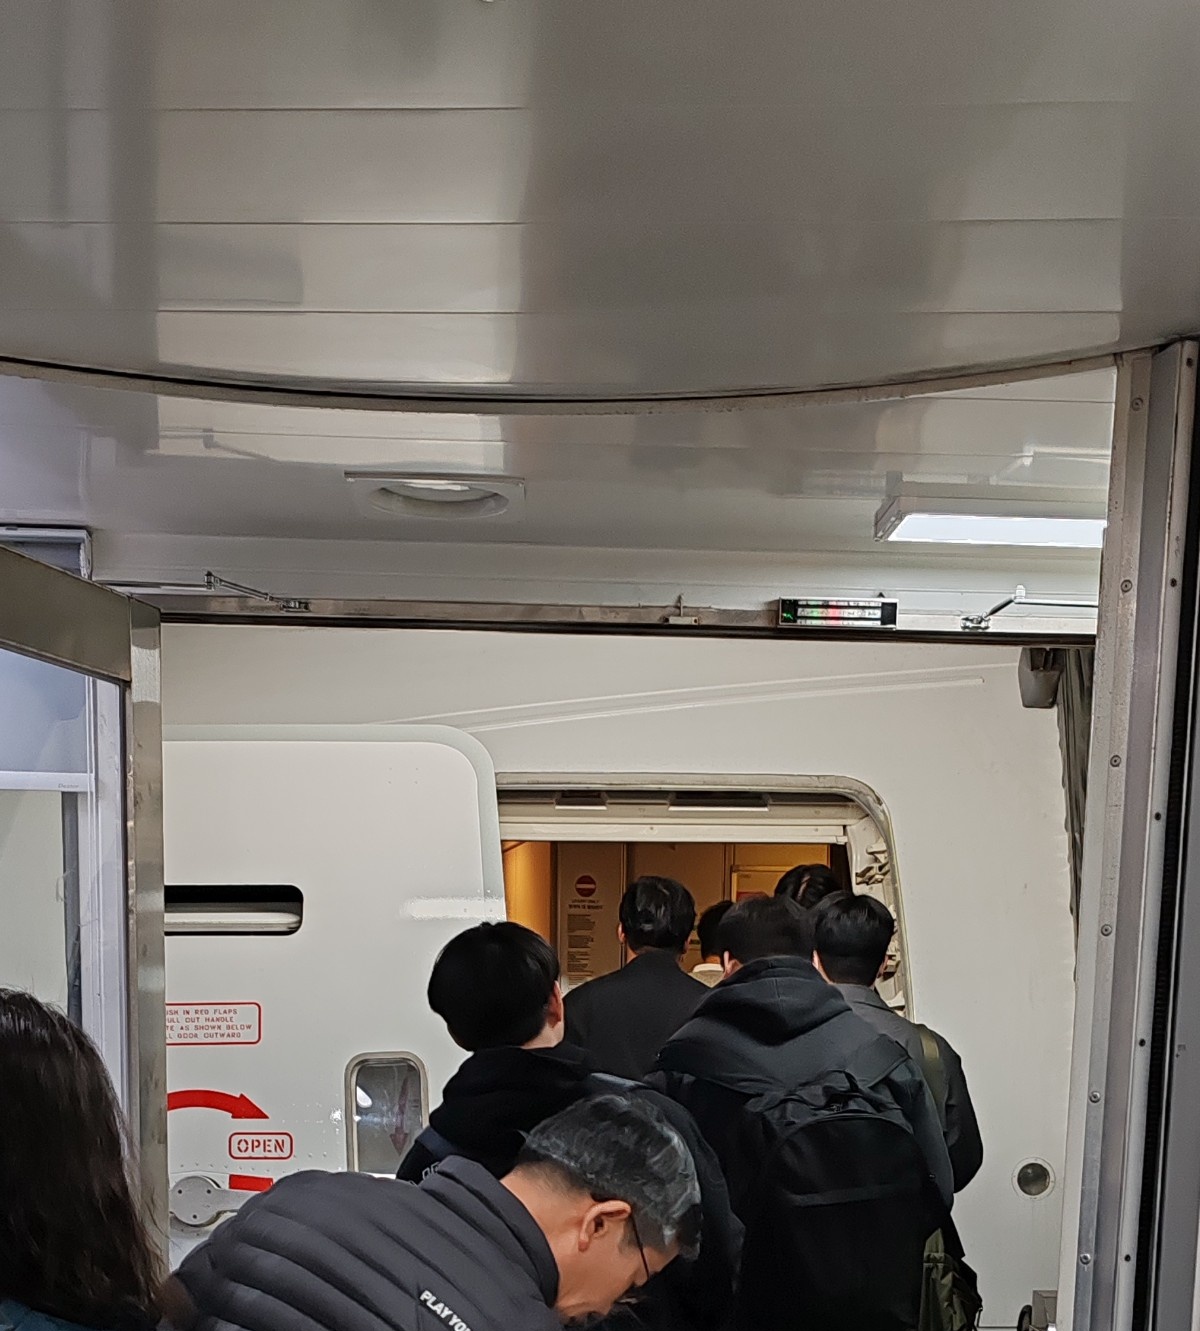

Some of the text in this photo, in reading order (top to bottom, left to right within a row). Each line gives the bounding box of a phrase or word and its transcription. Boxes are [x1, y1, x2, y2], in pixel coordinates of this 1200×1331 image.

[194, 1008, 210, 1016] RED
[226, 1023, 253, 1031] BELOW
[203, 1031, 242, 1039] OUTWARD
[236, 1138, 286, 1154] OPEN
[419, 1289, 454, 1319] PLAY
